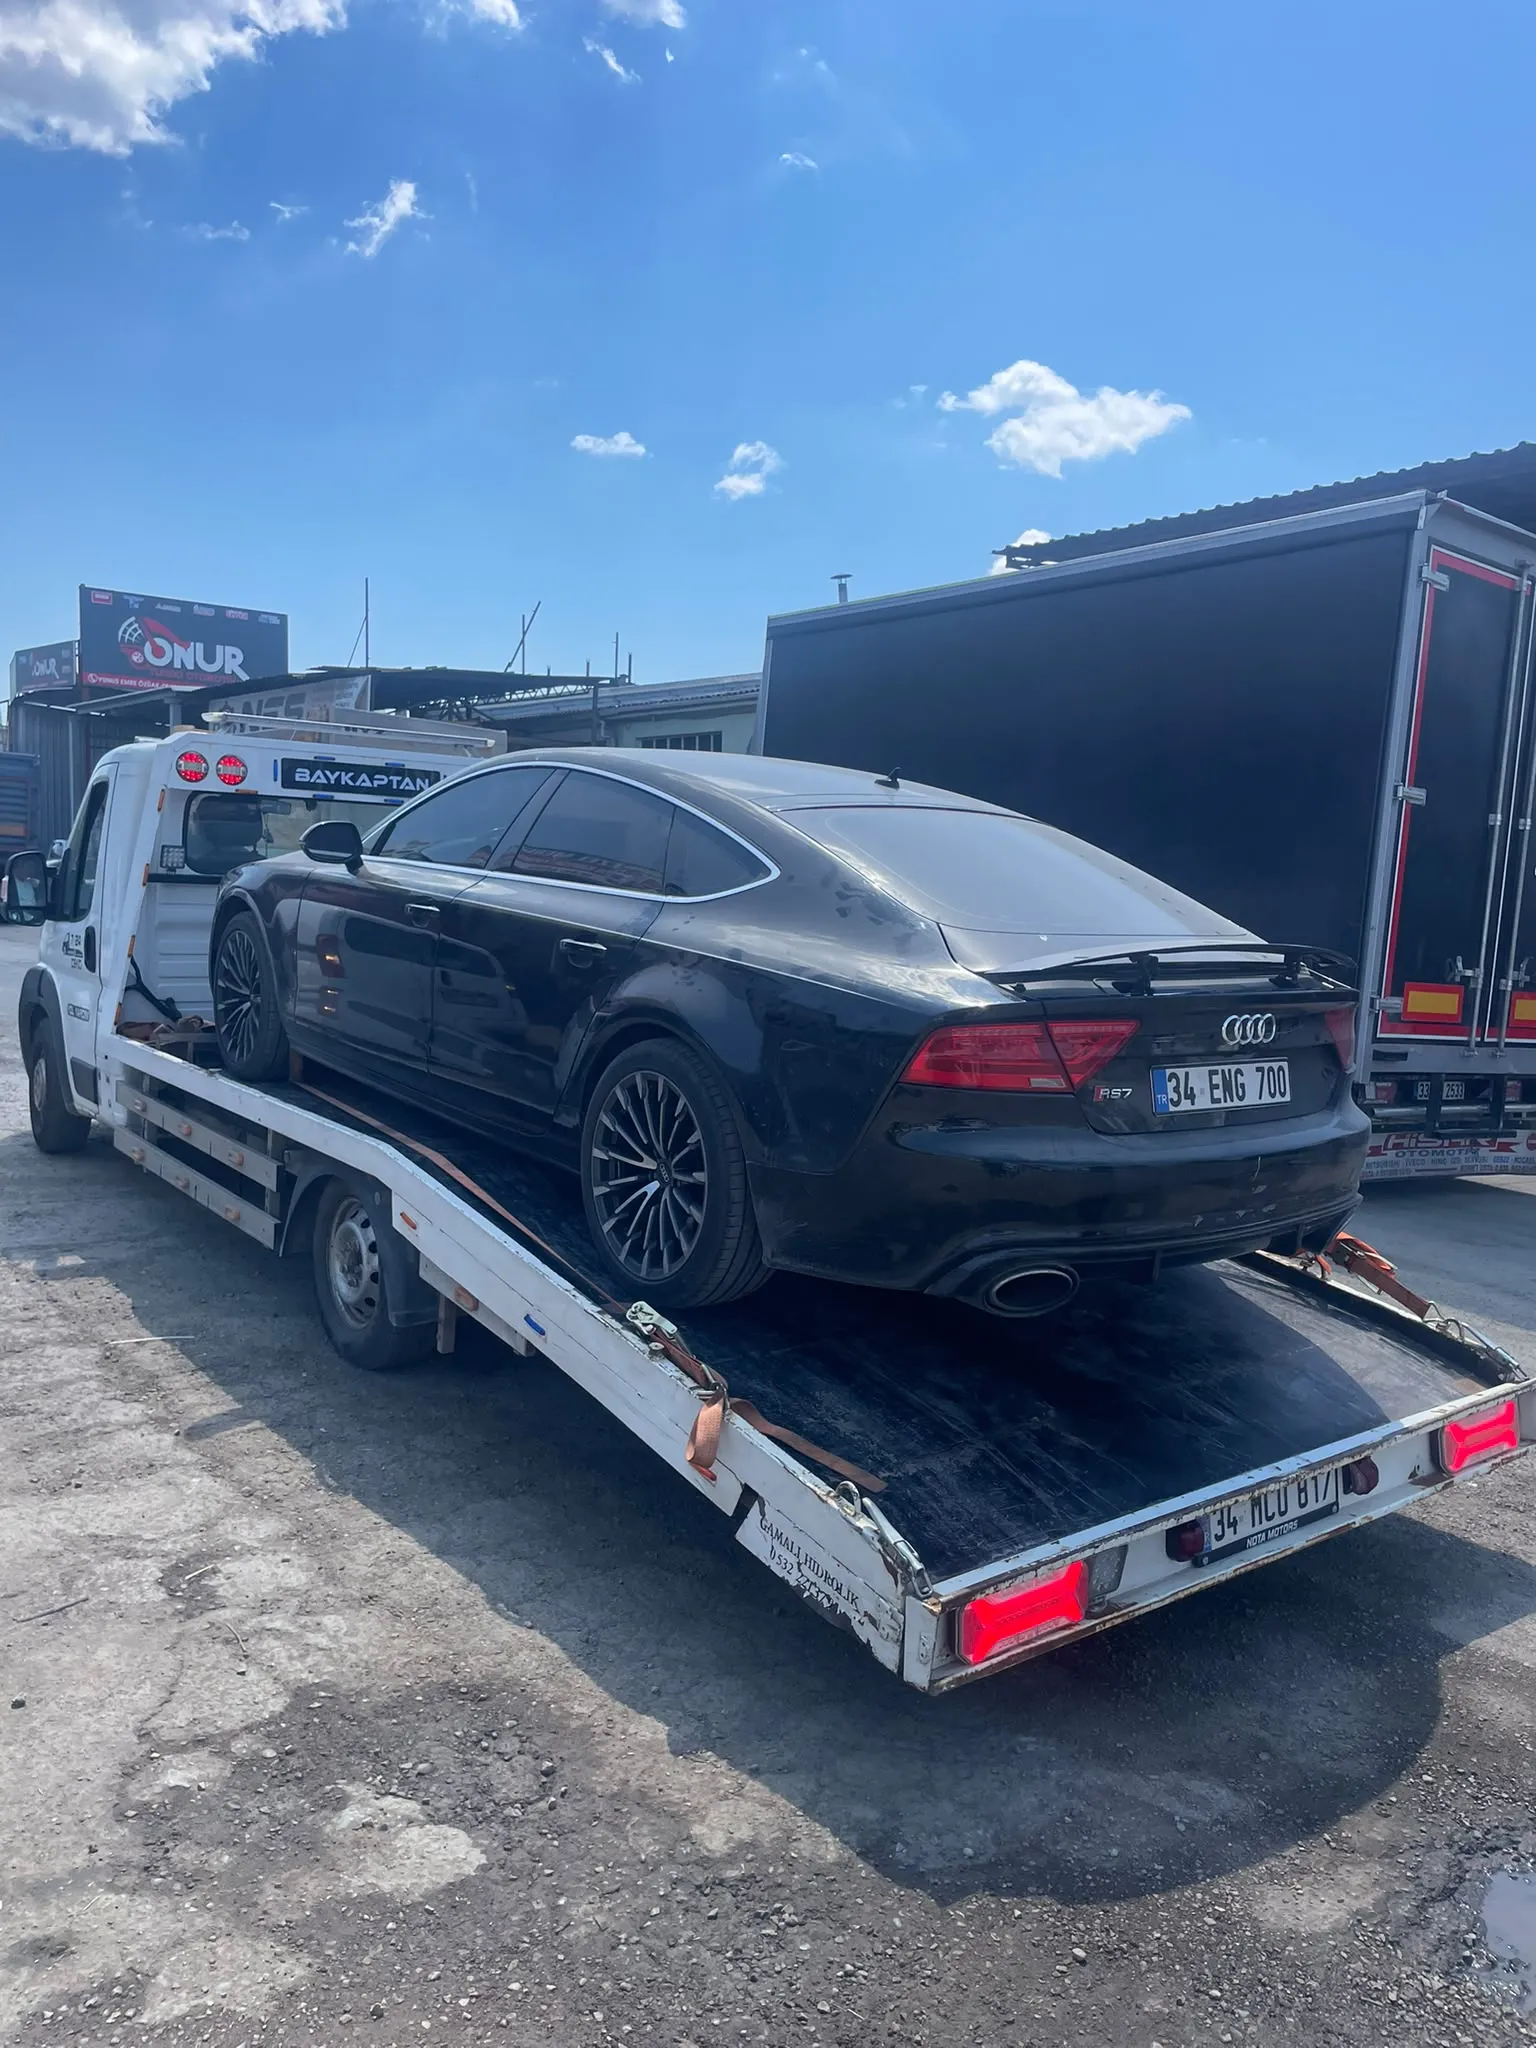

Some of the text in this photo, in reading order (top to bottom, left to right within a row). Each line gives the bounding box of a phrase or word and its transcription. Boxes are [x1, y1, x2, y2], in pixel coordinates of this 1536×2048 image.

[144, 637, 251, 682] ONUR
[295, 767, 430, 792] BAYKAPTAN
[1099, 1087, 1133, 1100] RS7
[1156, 1064, 1287, 1108] TR 34 ENG 700
[1213, 1504, 1239, 1542] 34
[1246, 1519, 1299, 1549] NOTA MOTORS
